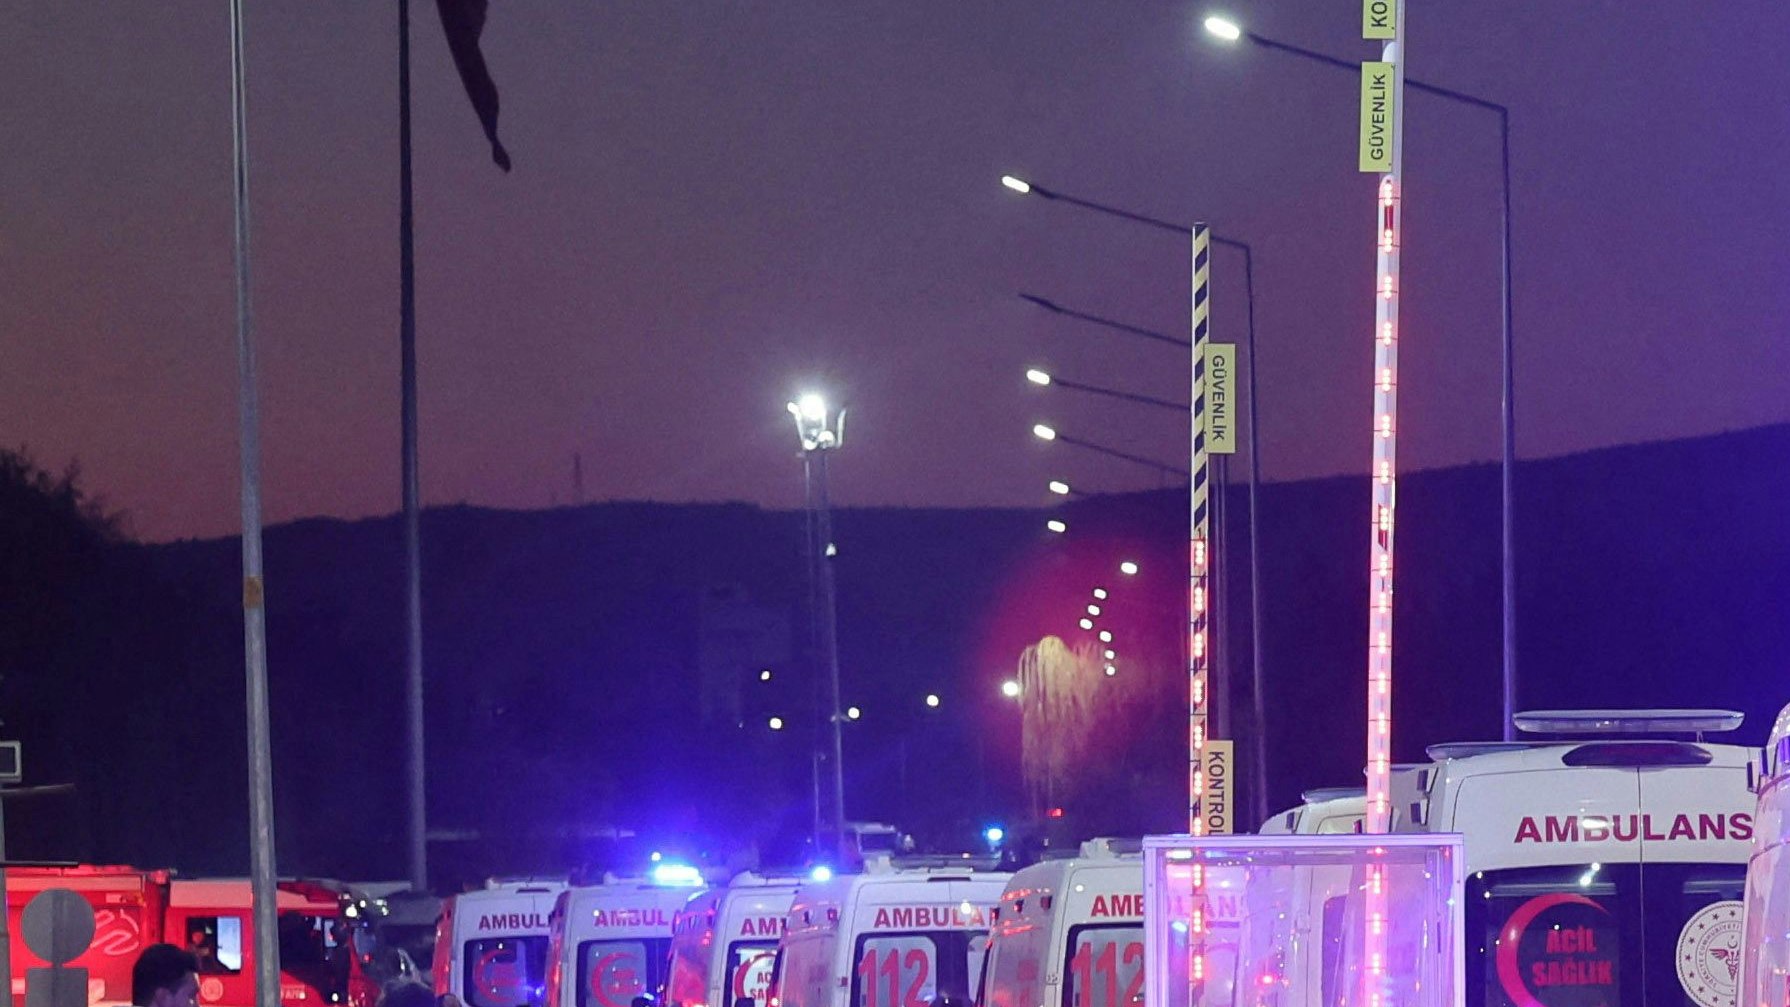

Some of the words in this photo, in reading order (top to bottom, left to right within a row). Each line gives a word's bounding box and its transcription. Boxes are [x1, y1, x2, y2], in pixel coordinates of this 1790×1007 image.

[1368, 73, 1386, 160] GÜVENLİK
[1212, 354, 1227, 440] GÜVENLİK
[1208, 751, 1225, 836] KONTROL
[1514, 812, 1754, 843] AMBULANS
[1546, 924, 1597, 953] ACİL
[1532, 956, 1614, 986] SAĞLIK
